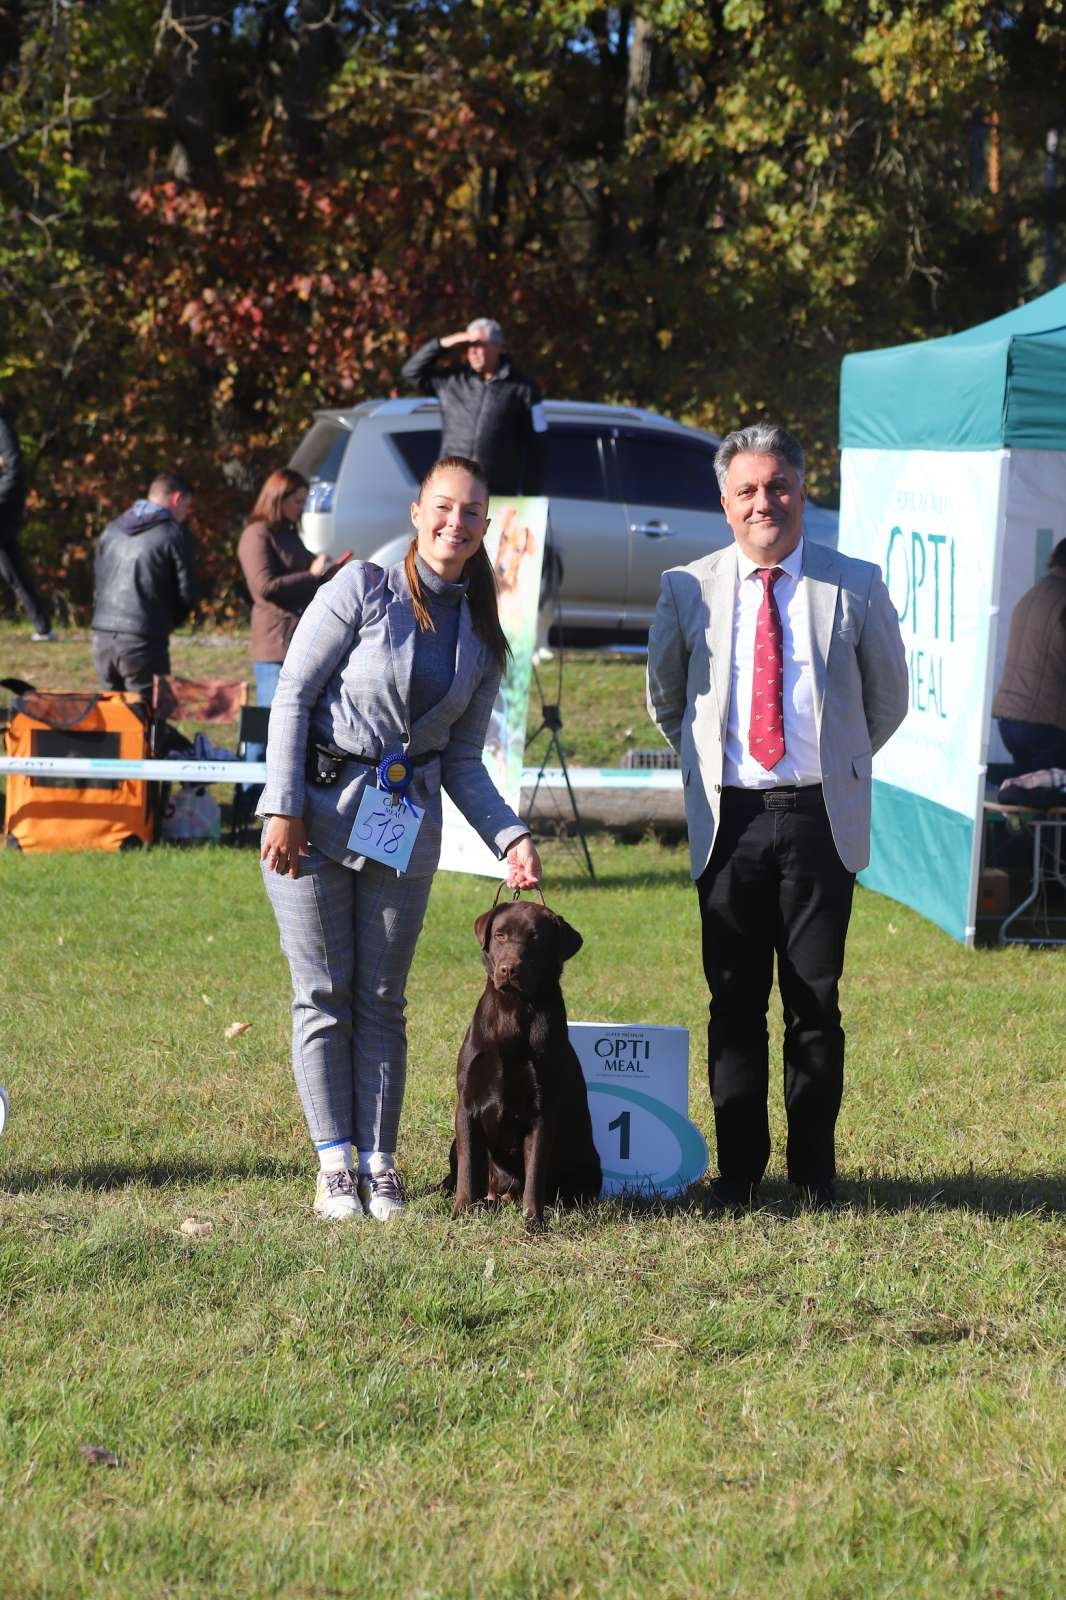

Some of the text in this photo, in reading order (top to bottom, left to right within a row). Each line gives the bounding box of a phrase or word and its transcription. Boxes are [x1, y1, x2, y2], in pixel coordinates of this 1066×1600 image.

[886, 526, 955, 642] OPTI
[594, 1038, 650, 1059] OPTI
[604, 1059, 644, 1073] MEAL
[608, 1111, 631, 1160] 1
